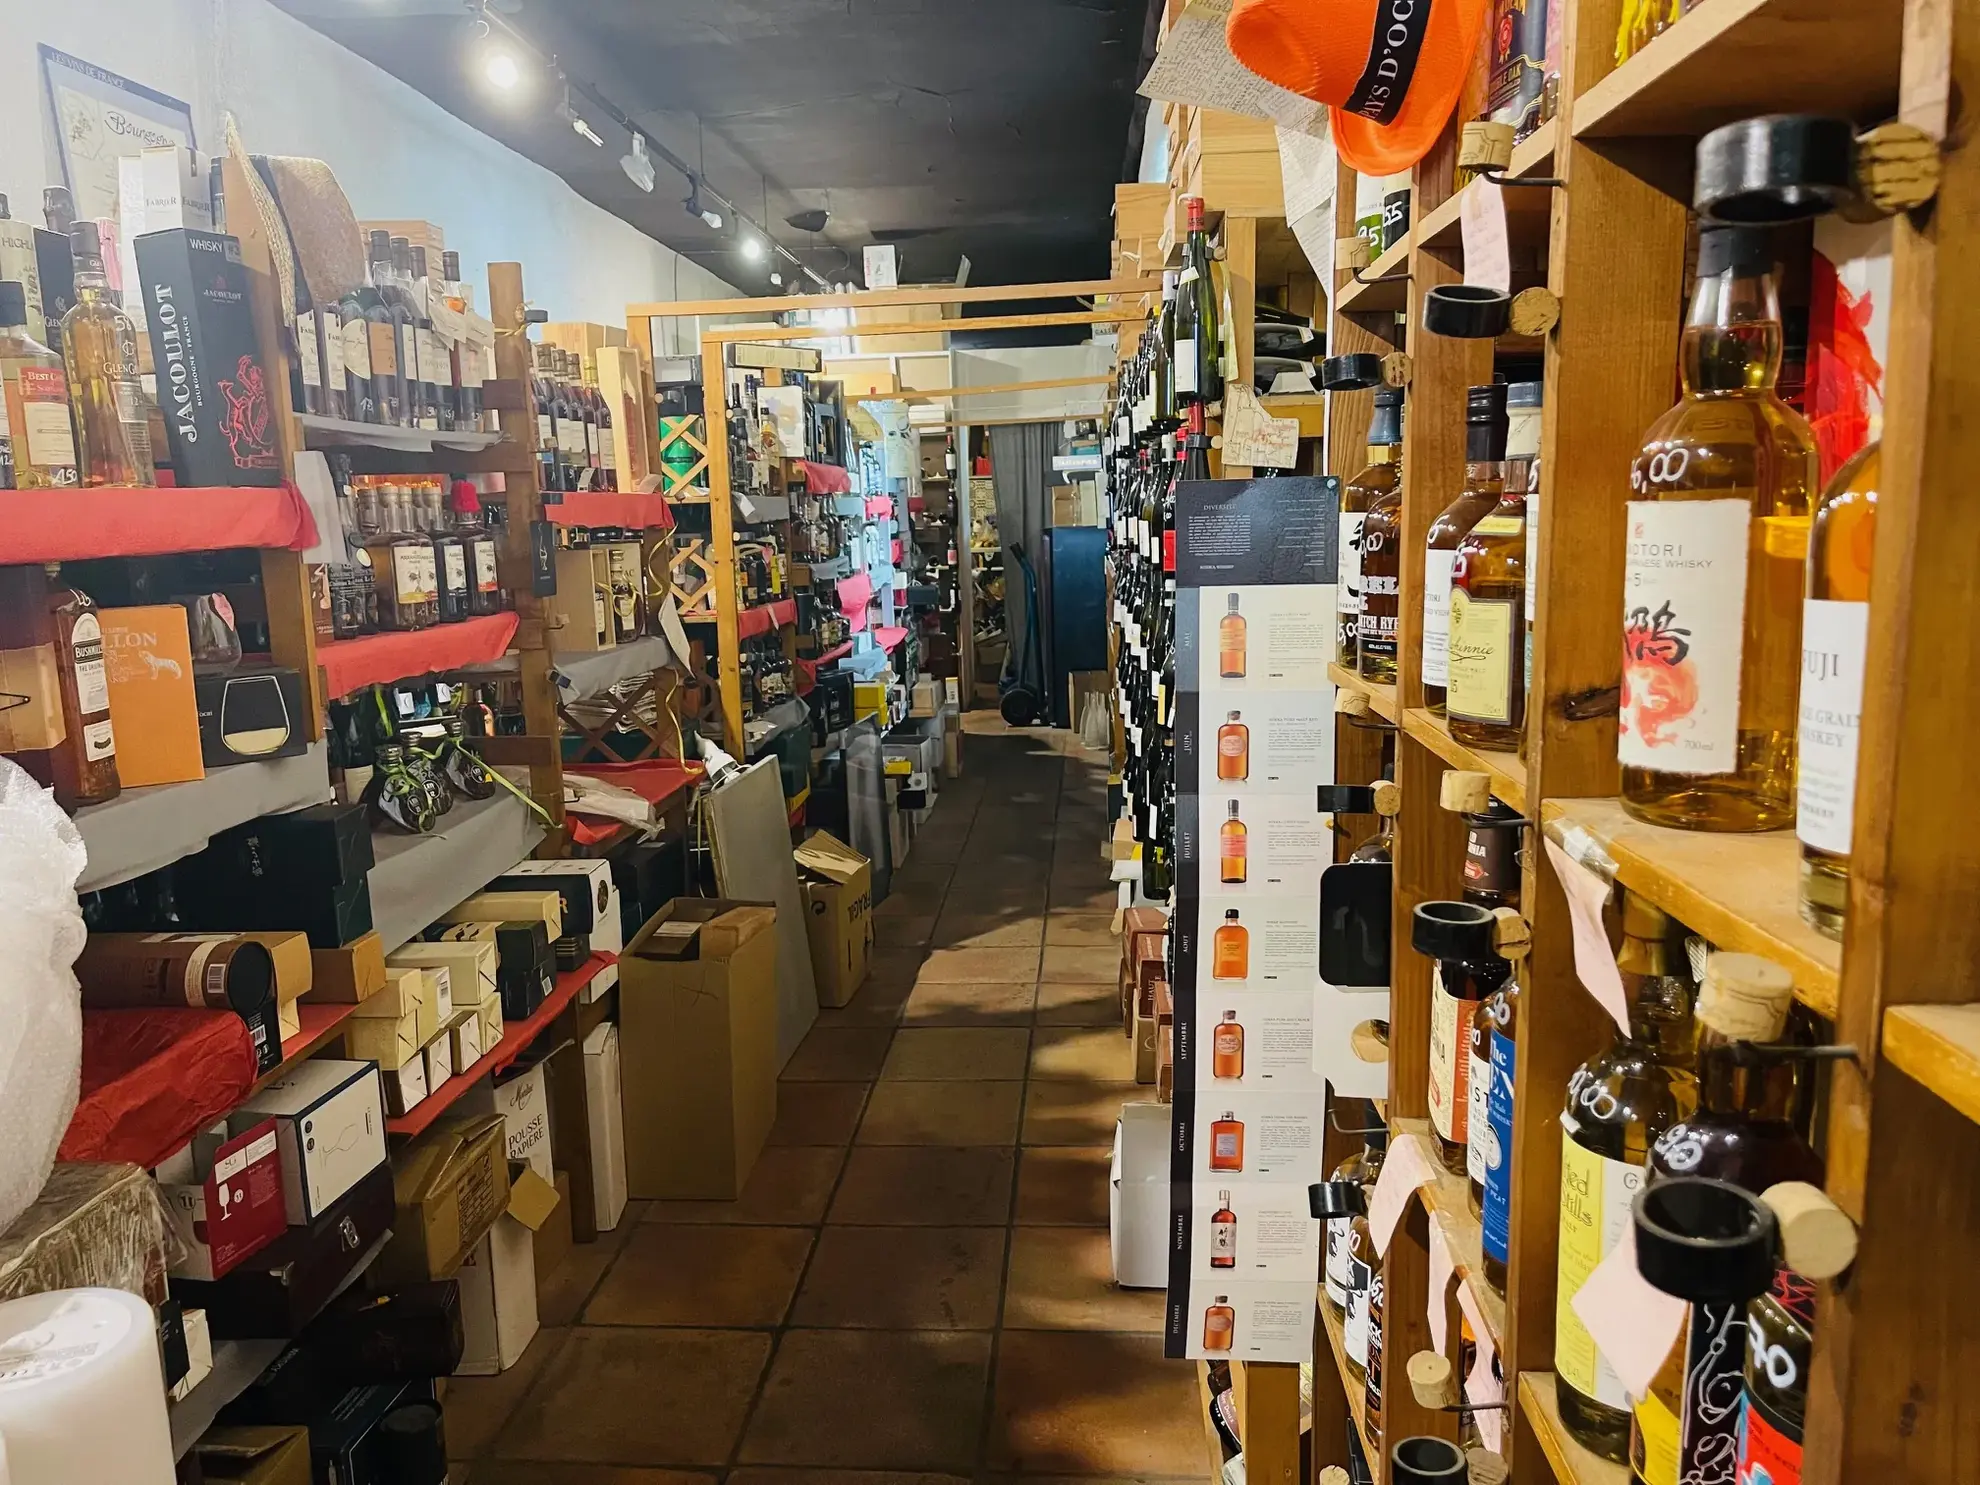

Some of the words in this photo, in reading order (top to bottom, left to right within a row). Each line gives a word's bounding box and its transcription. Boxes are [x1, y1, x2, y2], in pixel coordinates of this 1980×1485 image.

[1358, 83, 1391, 120] PAYS
[189, 237, 223, 254] WHISKY
[182, 314, 192, 350] FRANCE
[153, 282, 198, 444] JACOULOT
[188, 355, 203, 407] BOURGOGNE
[1664, 559, 1713, 569] WHISKY
[1183, 733, 1191, 754] JUIN
[1183, 831, 1191, 859] JUILLET
[508, 1113, 543, 1150] POUSSE
[1178, 1121, 1186, 1152] OCTOBRE
[1176, 1214, 1184, 1250] NOVEMBRE
